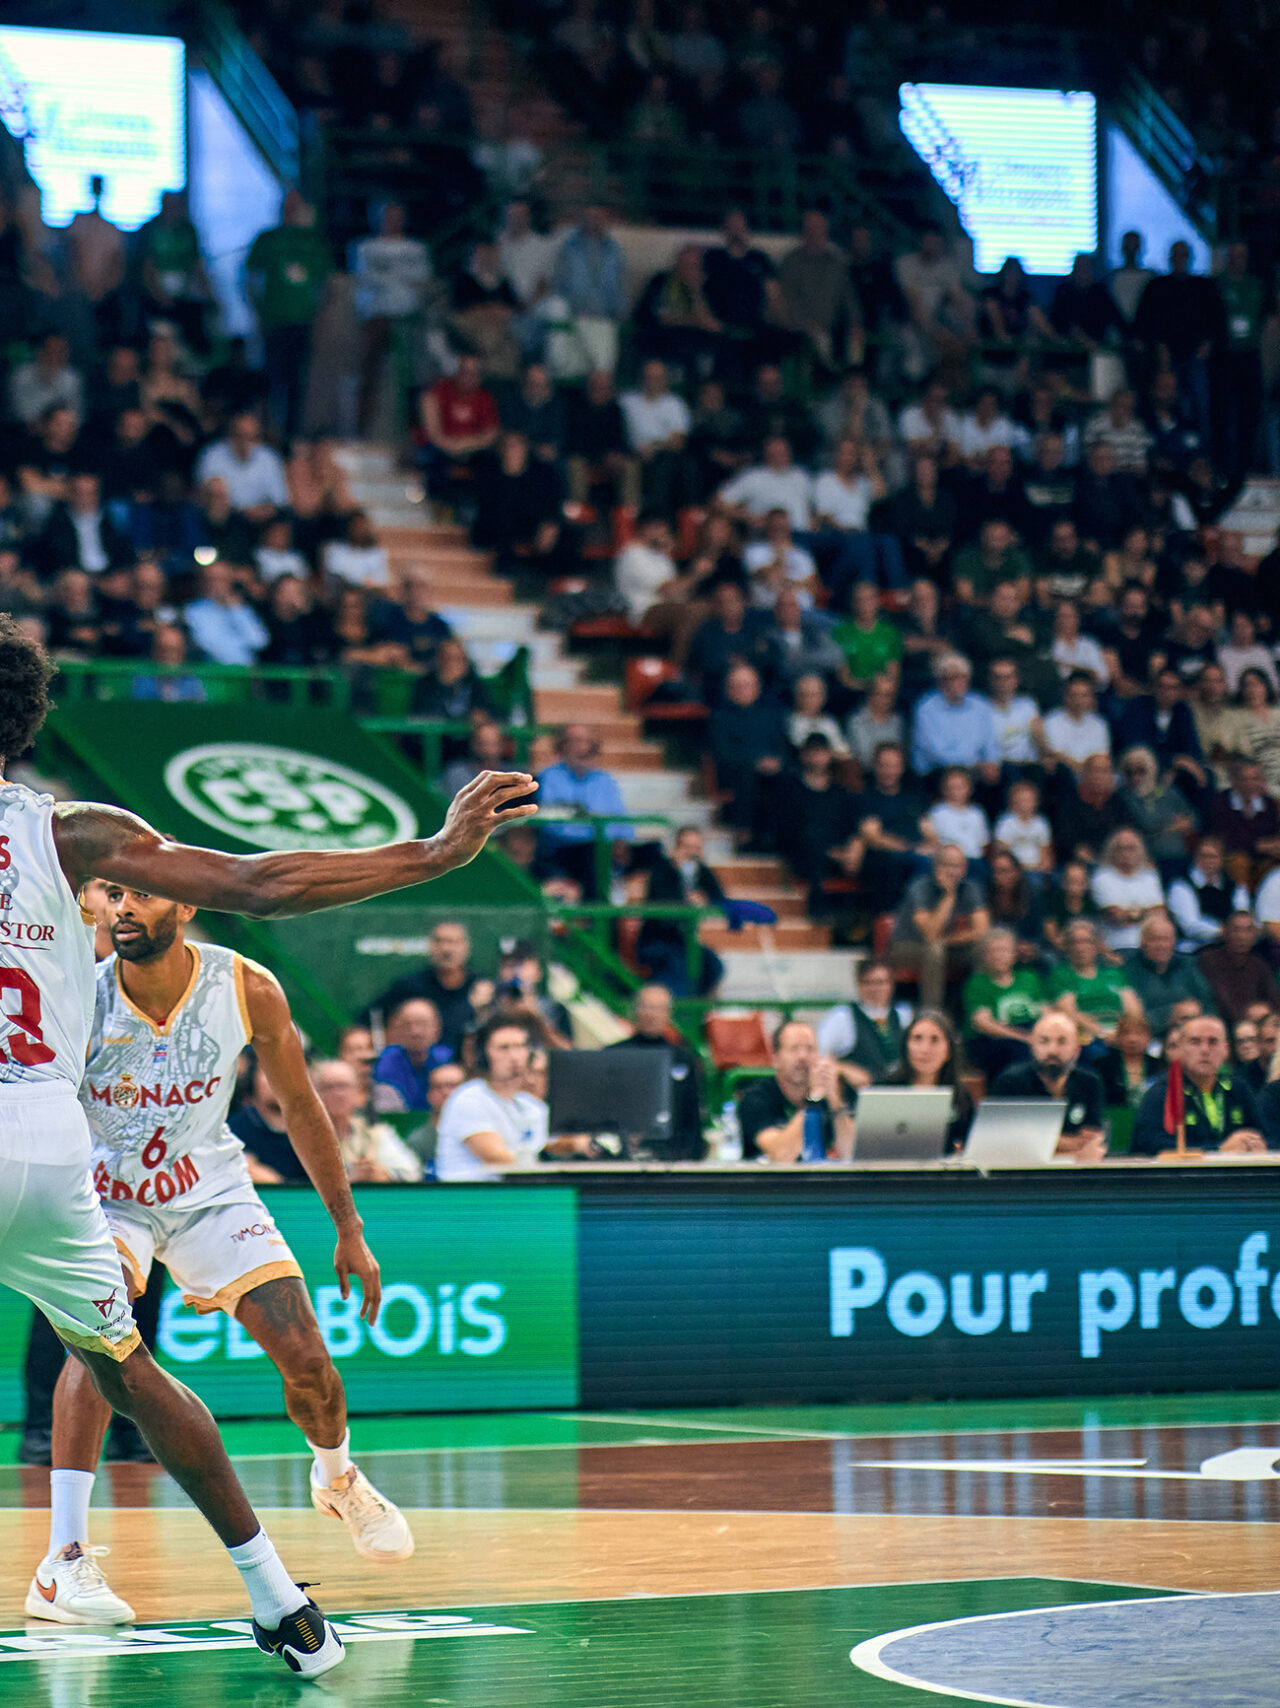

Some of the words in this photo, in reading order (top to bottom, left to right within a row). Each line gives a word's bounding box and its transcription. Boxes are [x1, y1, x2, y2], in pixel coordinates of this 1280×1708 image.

[141, 1125, 168, 1170] 6
[828, 1245, 1049, 1338] Pour
[1078, 1230, 1280, 1359] prof
